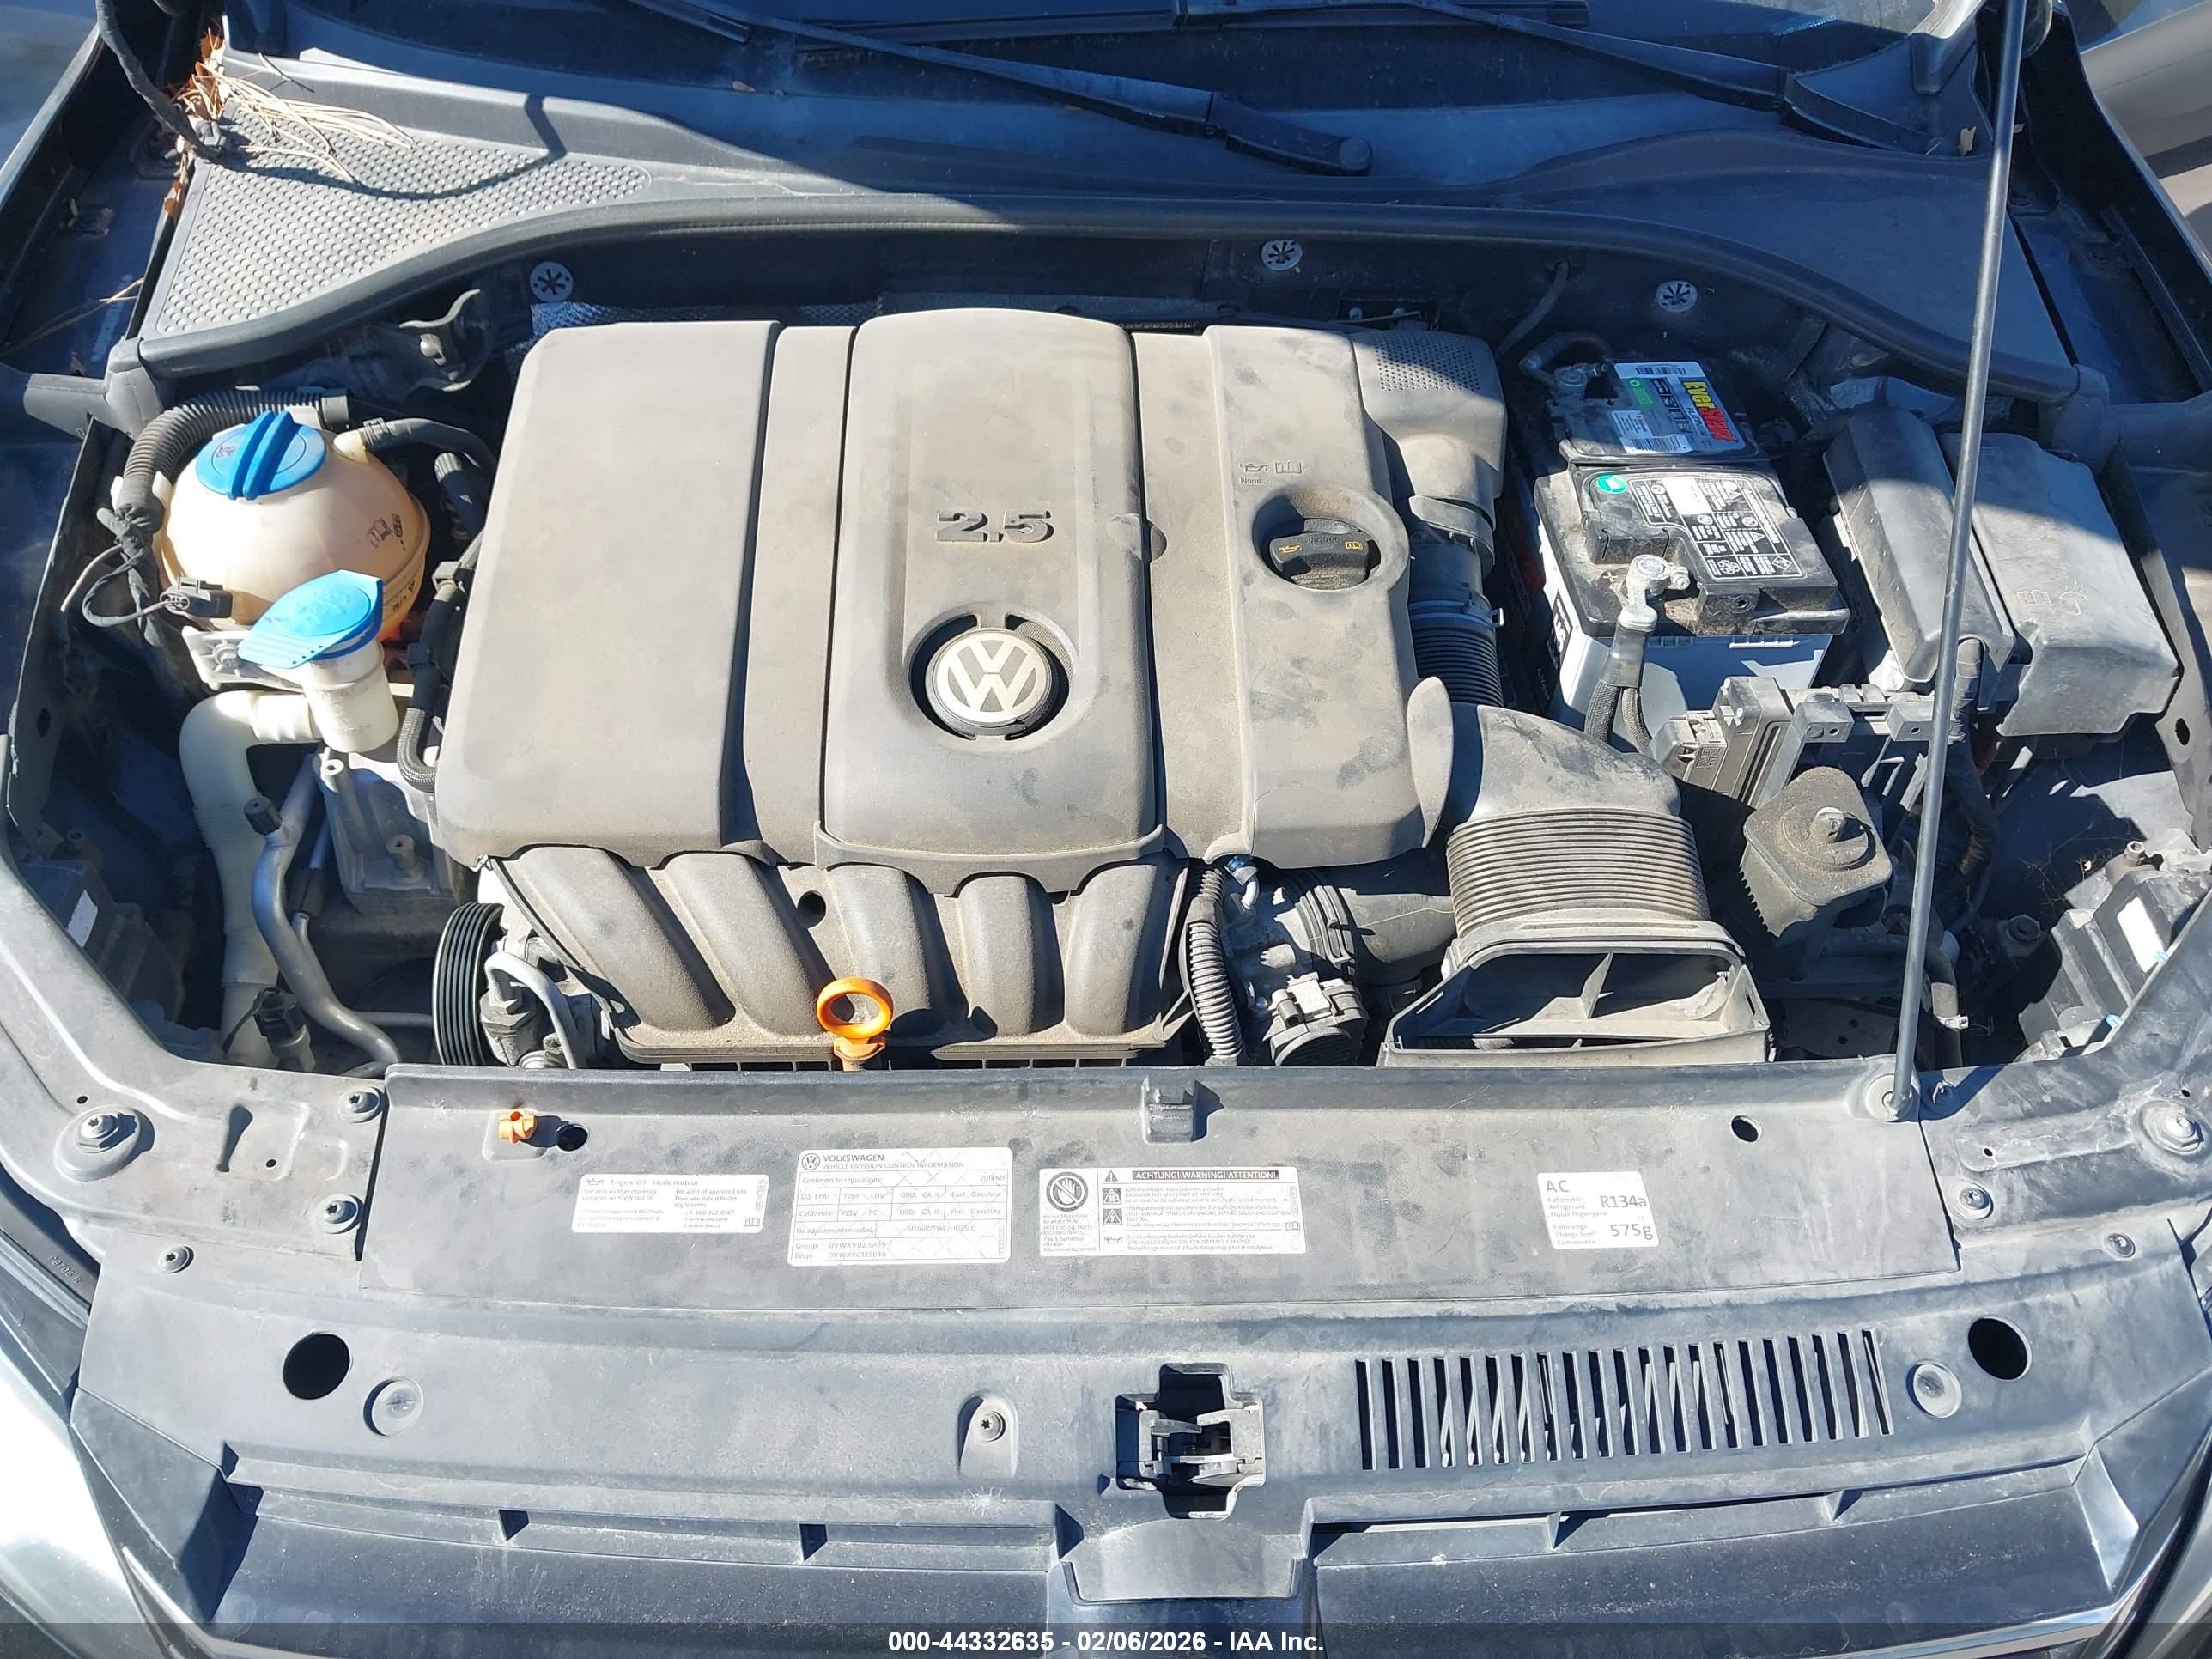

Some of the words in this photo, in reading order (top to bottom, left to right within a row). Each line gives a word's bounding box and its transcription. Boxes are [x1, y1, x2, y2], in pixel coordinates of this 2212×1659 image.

[1683, 381, 1737, 441] EverStart
[936, 509, 1055, 543] 2.5
[392, 595, 407, 612] min
[936, 633, 1048, 723] VW
[1135, 1170, 1180, 1180] ACHTUNG!
[1182, 1170, 1226, 1179] WARNING!
[1228, 1170, 1278, 1179] ATTENTION!
[1546, 1180, 1571, 1193] AC
[1600, 1195, 1648, 1208] R134a
